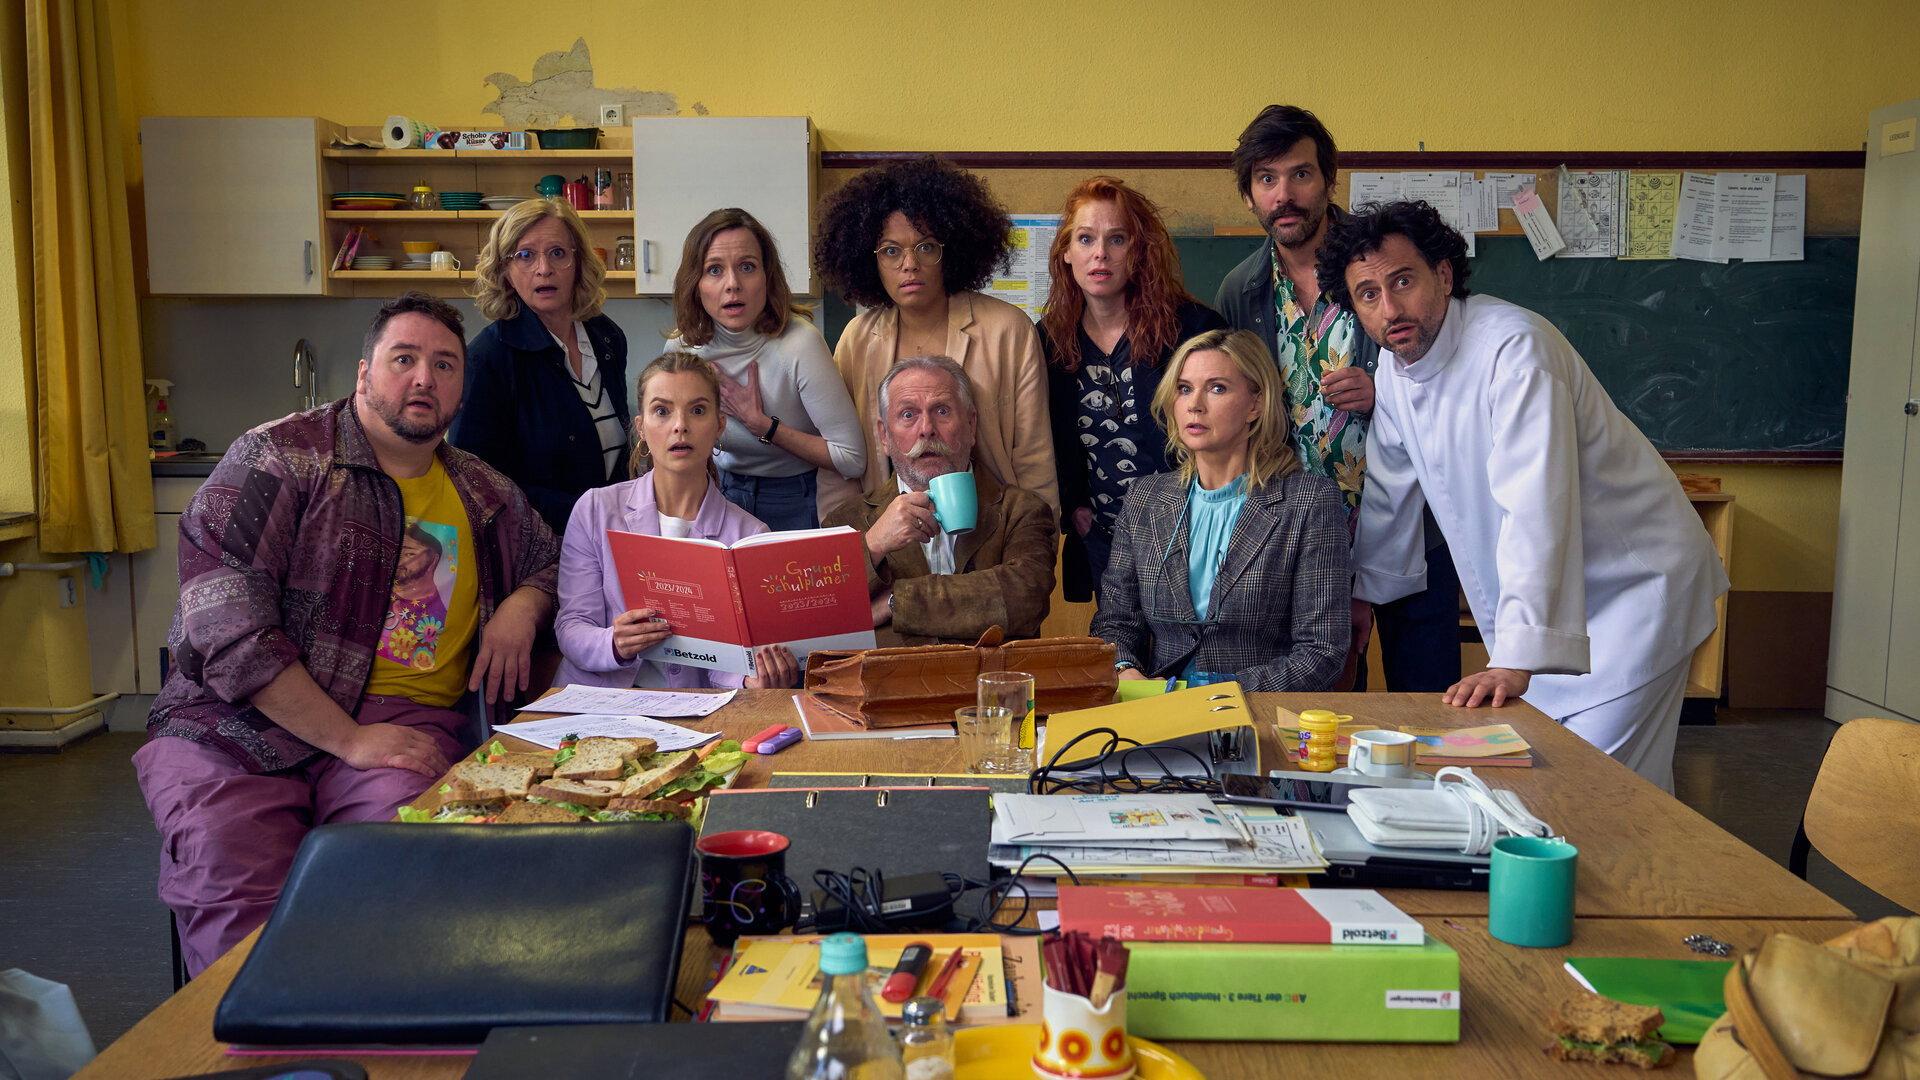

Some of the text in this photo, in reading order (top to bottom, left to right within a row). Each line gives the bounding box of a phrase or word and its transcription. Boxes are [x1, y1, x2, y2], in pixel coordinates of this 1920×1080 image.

[654, 581, 693, 595] 2023/2024
[780, 597, 838, 611] 2023/2024
[674, 648, 717, 663] Betzold
[1342, 929, 1388, 941] Betzold
[1168, 992, 1221, 1002] Handbuch
[1228, 992, 1234, 1002] 3
[1237, 993, 1262, 1003] Tiere
[1265, 993, 1282, 1001] der
[1285, 993, 1307, 1003] ABC
